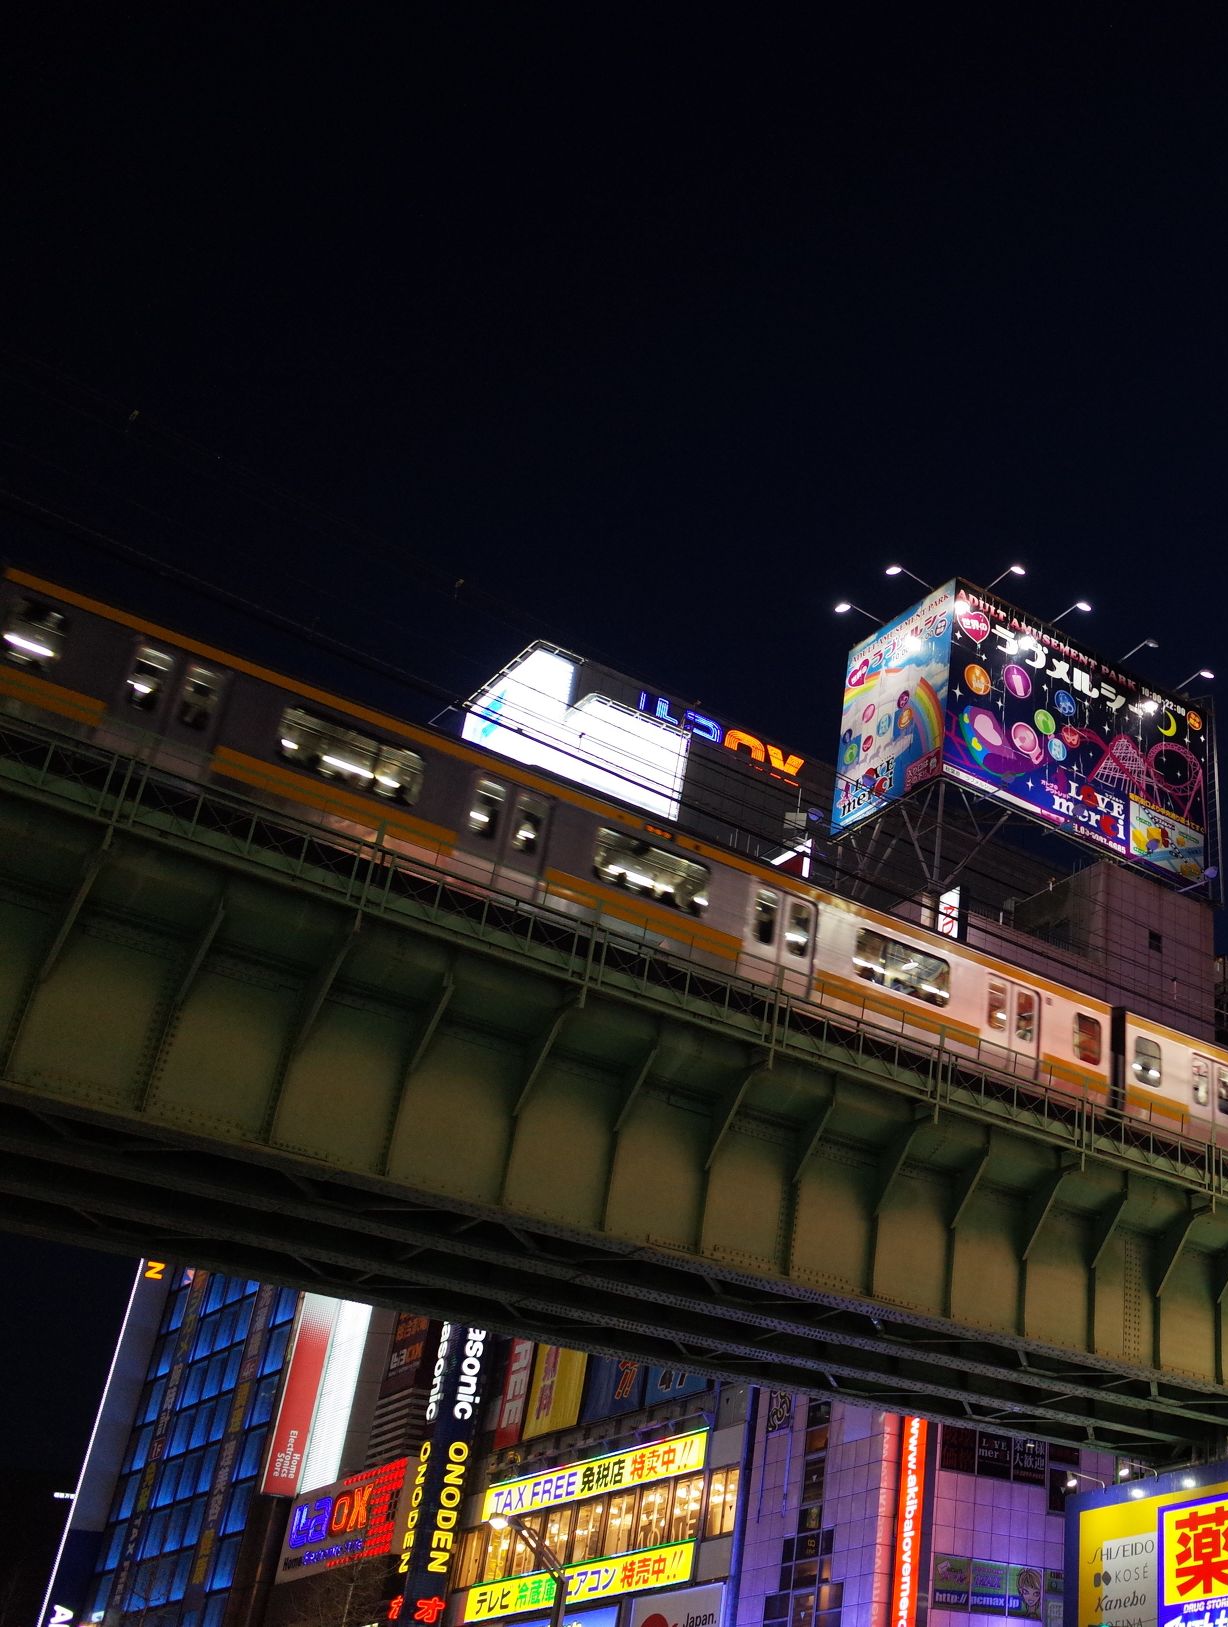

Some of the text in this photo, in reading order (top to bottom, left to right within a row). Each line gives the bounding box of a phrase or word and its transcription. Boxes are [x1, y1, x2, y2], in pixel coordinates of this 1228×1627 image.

[928, 593, 950, 611] PARK
[957, 589, 1137, 692] ADULT AMUSEMENT PARK
[1068, 780, 1125, 820] LOVE
[273, 1452, 285, 1477] Store
[281, 1430, 298, 1478] Electronics
[288, 1453, 301, 1479] Home
[494, 1485, 527, 1513] TAX
[530, 1471, 578, 1505] FREE
[580, 1459, 626, 1493] 免税店
[398, 1441, 431, 1574] ONODEN
[427, 1441, 469, 1573] ONODEN
[1088, 1539, 1155, 1565] SHISEIDO
[1115, 1562, 1149, 1584] KOSÉ
[475, 1585, 512, 1615] テレビ
[514, 1577, 556, 1609] 冷蔵庫
[565, 1566, 616, 1597] エアコン
[1095, 1590, 1146, 1613] Kanebo
[414, 1596, 446, 1624] オ
[1183, 1601, 1205, 1614] DRUG
